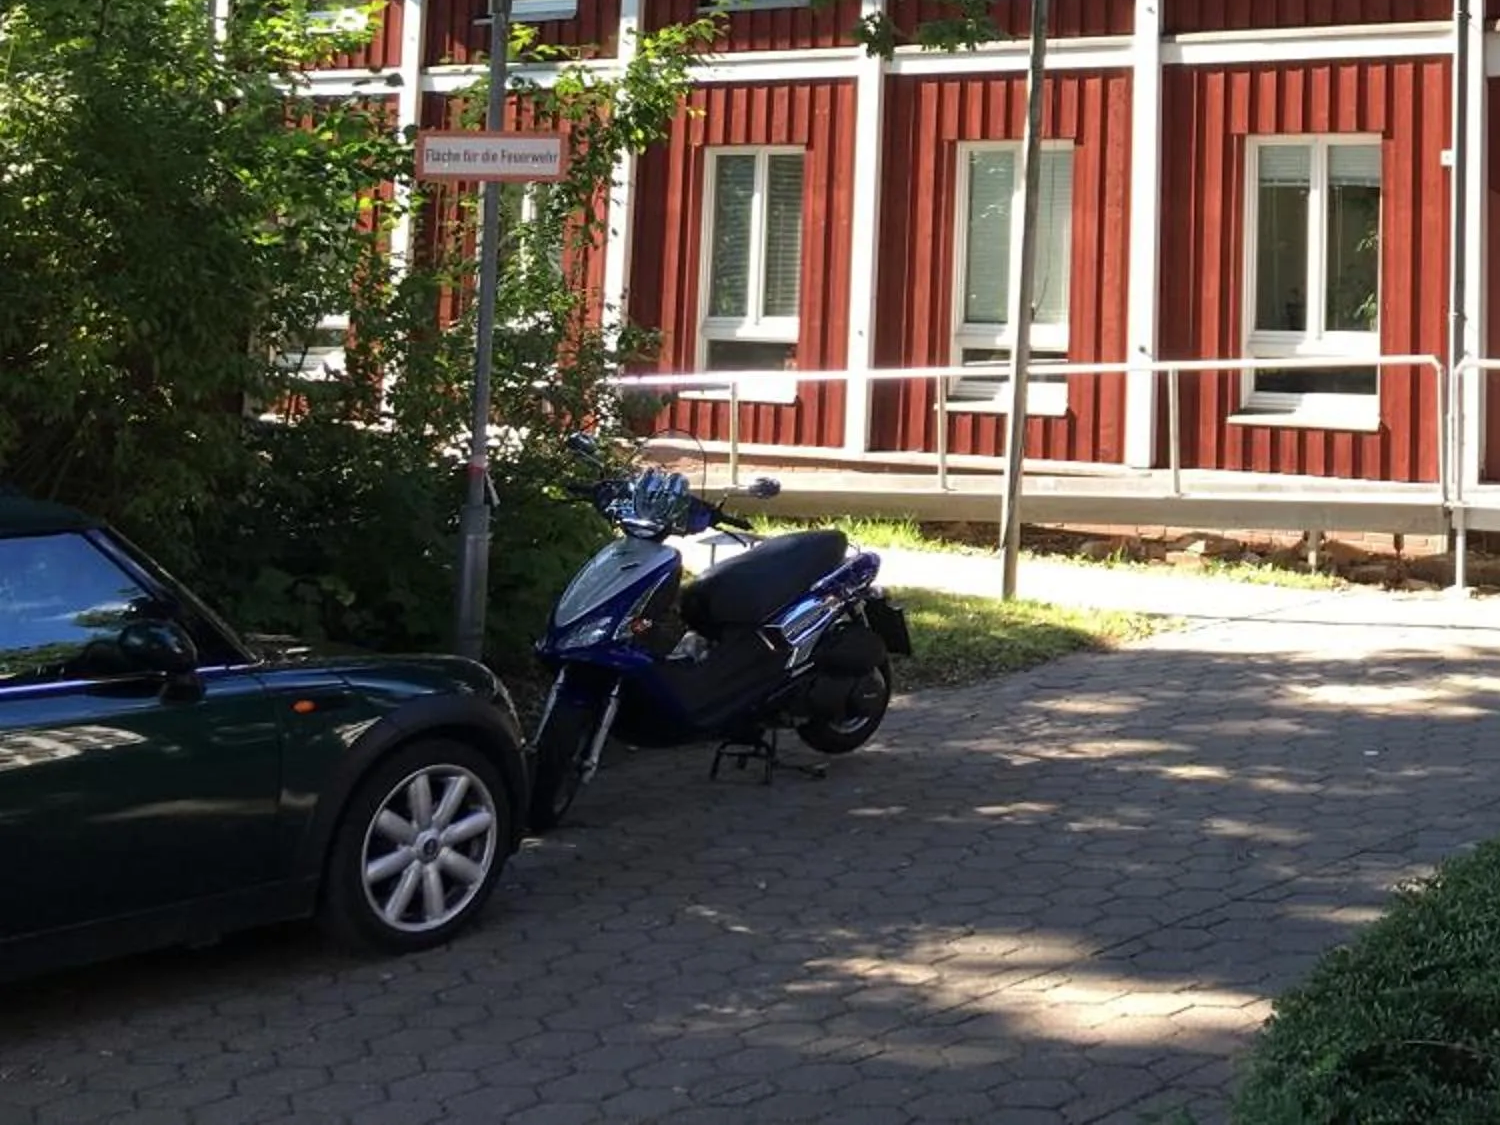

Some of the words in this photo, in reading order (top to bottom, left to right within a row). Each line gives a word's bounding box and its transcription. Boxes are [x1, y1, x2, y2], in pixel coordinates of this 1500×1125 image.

[426, 148, 461, 164] Fläche
[463, 148, 480, 163] für
[481, 148, 498, 163] die
[501, 148, 558, 164] Feuerwehr
